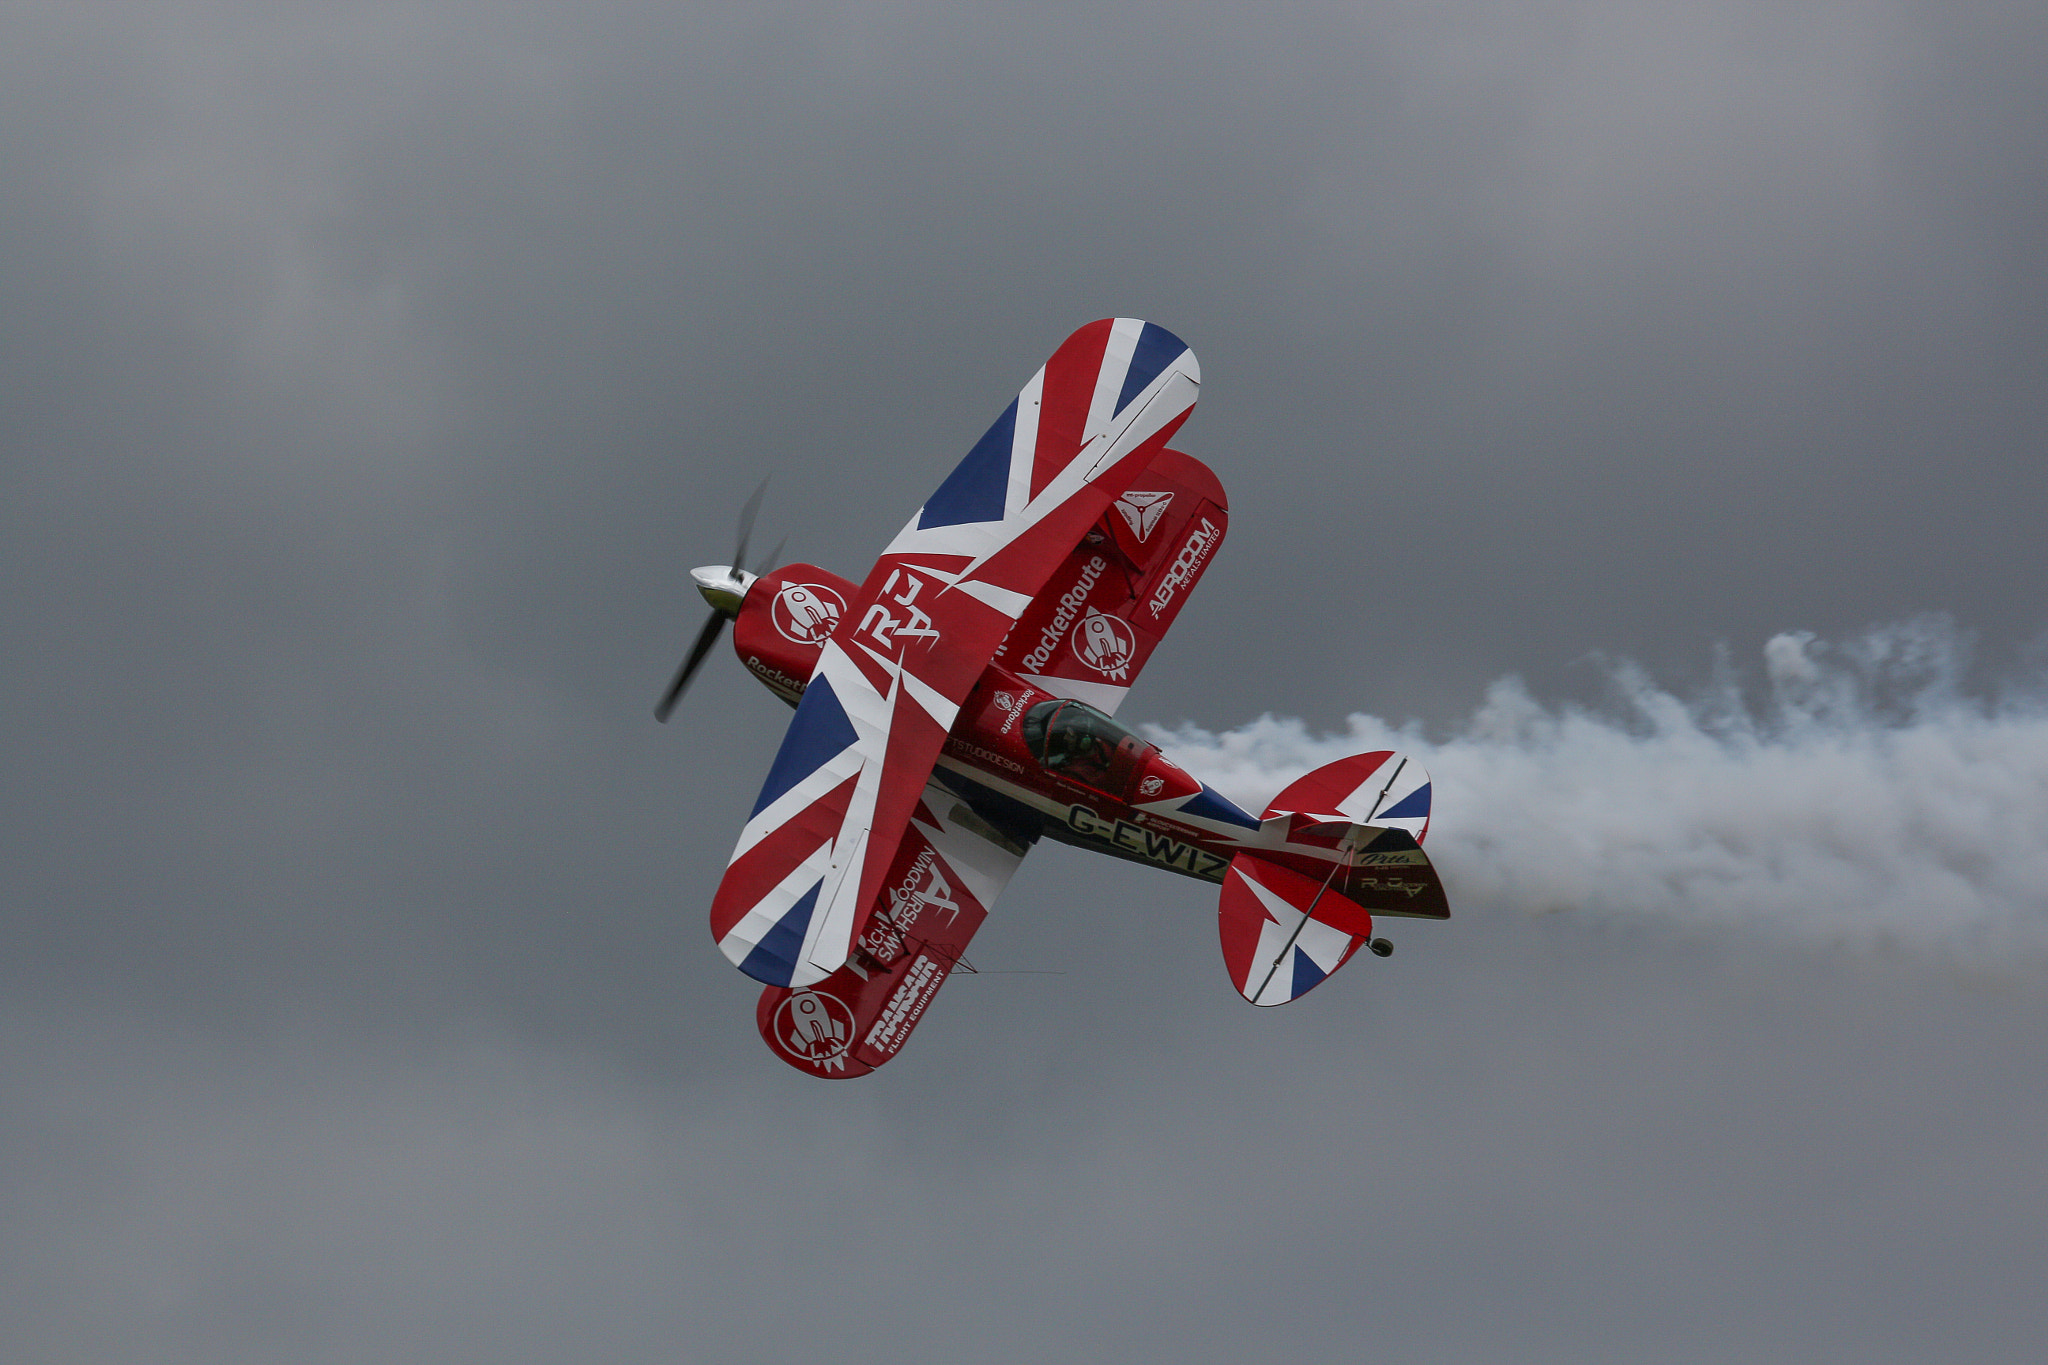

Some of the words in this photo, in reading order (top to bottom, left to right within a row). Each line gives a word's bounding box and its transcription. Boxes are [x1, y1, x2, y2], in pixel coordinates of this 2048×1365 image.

[1149, 517, 1215, 620] AEROCOM
[1180, 559, 1201, 590] METALS
[1199, 528, 1220, 559] LIMITED
[1022, 556, 1106, 674] RocketRoute
[1001, 689, 1035, 735] RocketRoute
[1068, 804, 1229, 879] G-EWIZ
[864, 954, 938, 1052] TRANSAIR
[888, 1021, 911, 1053] FLIGHT
[909, 969, 945, 1021] EQUIPMENT
